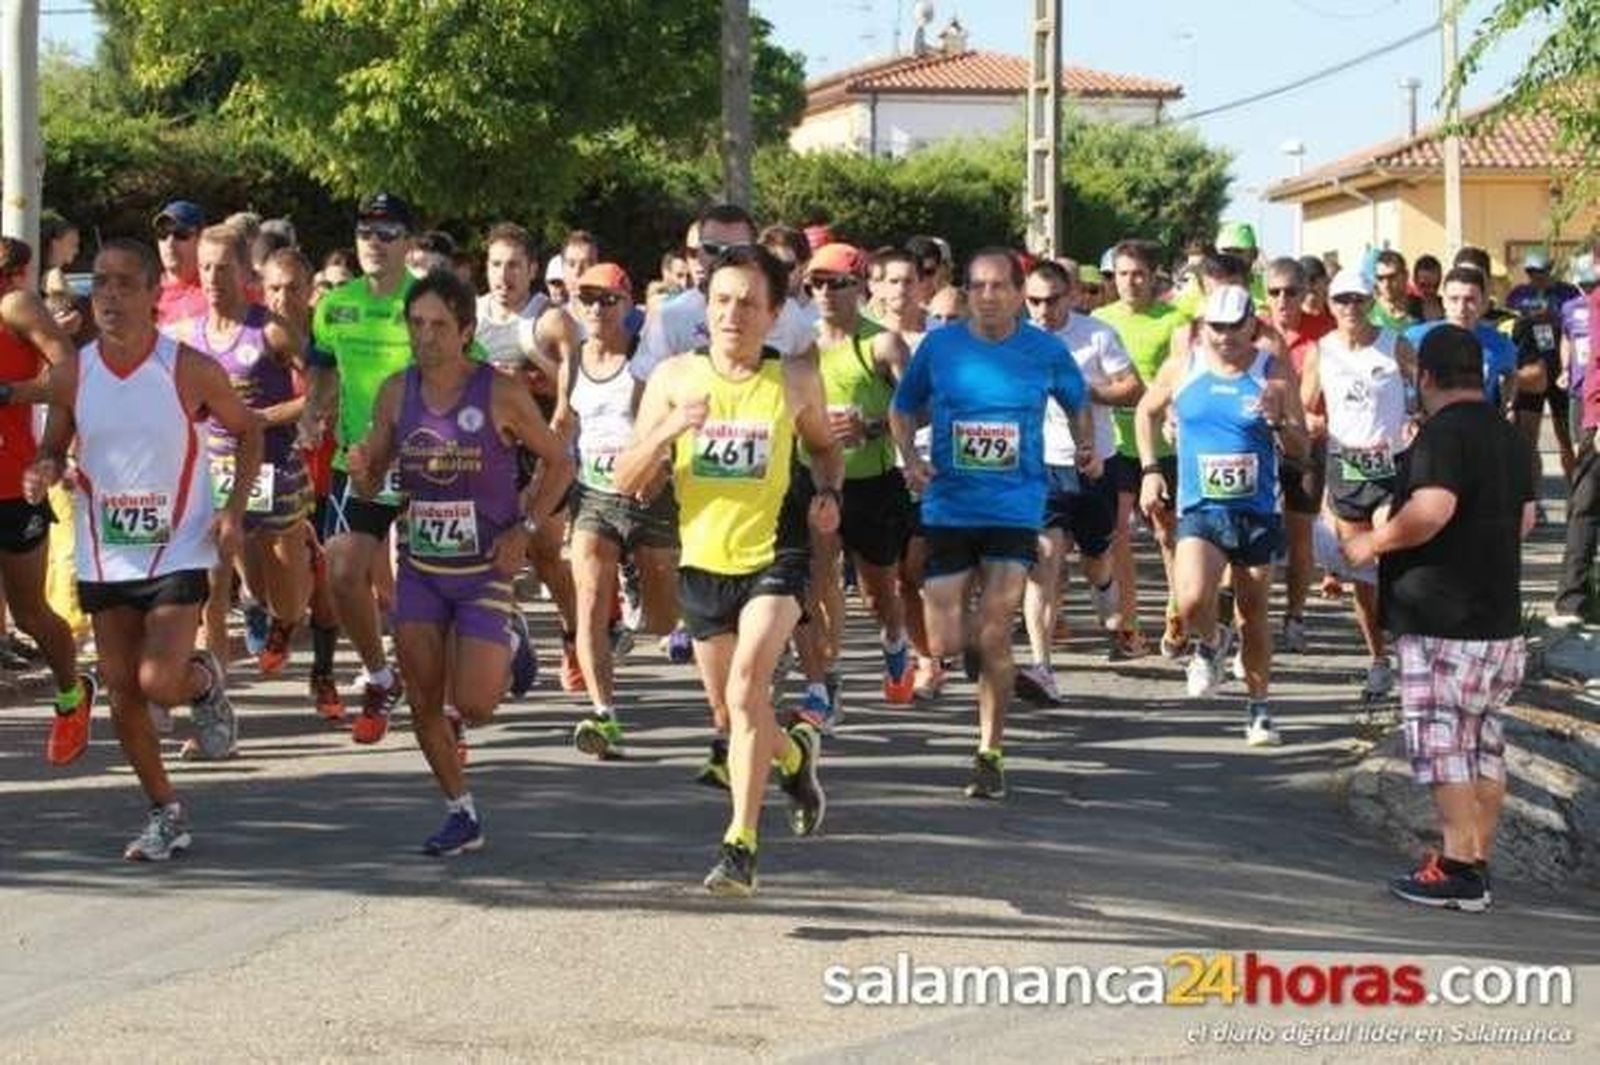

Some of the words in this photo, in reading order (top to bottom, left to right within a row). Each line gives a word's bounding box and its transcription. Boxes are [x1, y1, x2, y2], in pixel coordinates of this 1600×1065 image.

[703, 440, 755, 466] 461
[964, 437, 1007, 458] 479
[1209, 468, 1247, 487] 451
[111, 507, 159, 532] 475
[418, 519, 464, 542] 474
